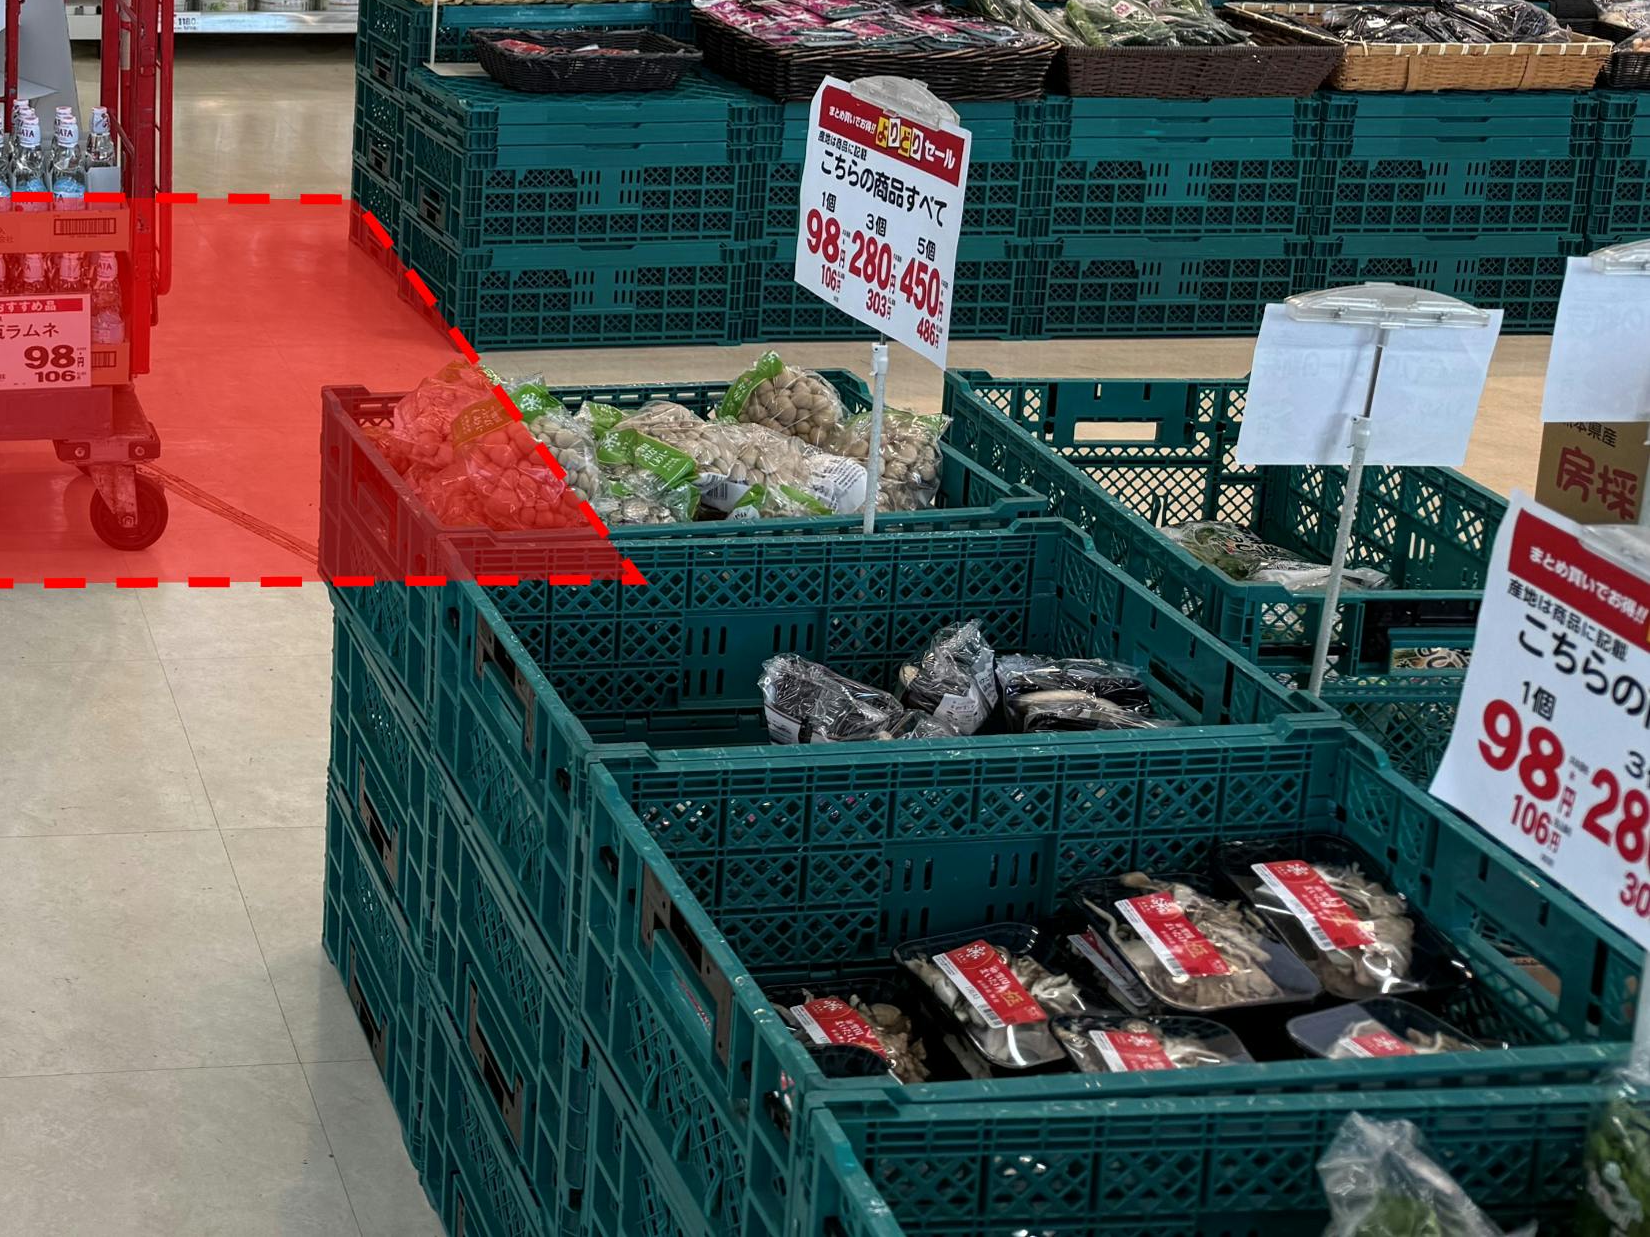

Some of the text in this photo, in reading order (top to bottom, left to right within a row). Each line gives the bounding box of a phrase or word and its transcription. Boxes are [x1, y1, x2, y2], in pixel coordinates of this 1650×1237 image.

[925, 140, 956, 170] セール
[821, 150, 947, 227] こちらの商品すべて
[822, 192, 837, 212] 1個
[806, 209, 841, 263] 98
[866, 213, 887, 237] 3個
[917, 237, 936, 262] 5個
[849, 230, 892, 290] 280
[900, 257, 940, 318] 450
[24, 345, 75, 369] 98
[35, 371, 75, 382] 106
[1507, 578, 1629, 662] 産地は商品に記載
[1518, 614, 1650, 728] こちらの
[1523, 682, 1557, 721] 1個
[1478, 699, 1565, 801] 98
[1582, 768, 1650, 864] 28
